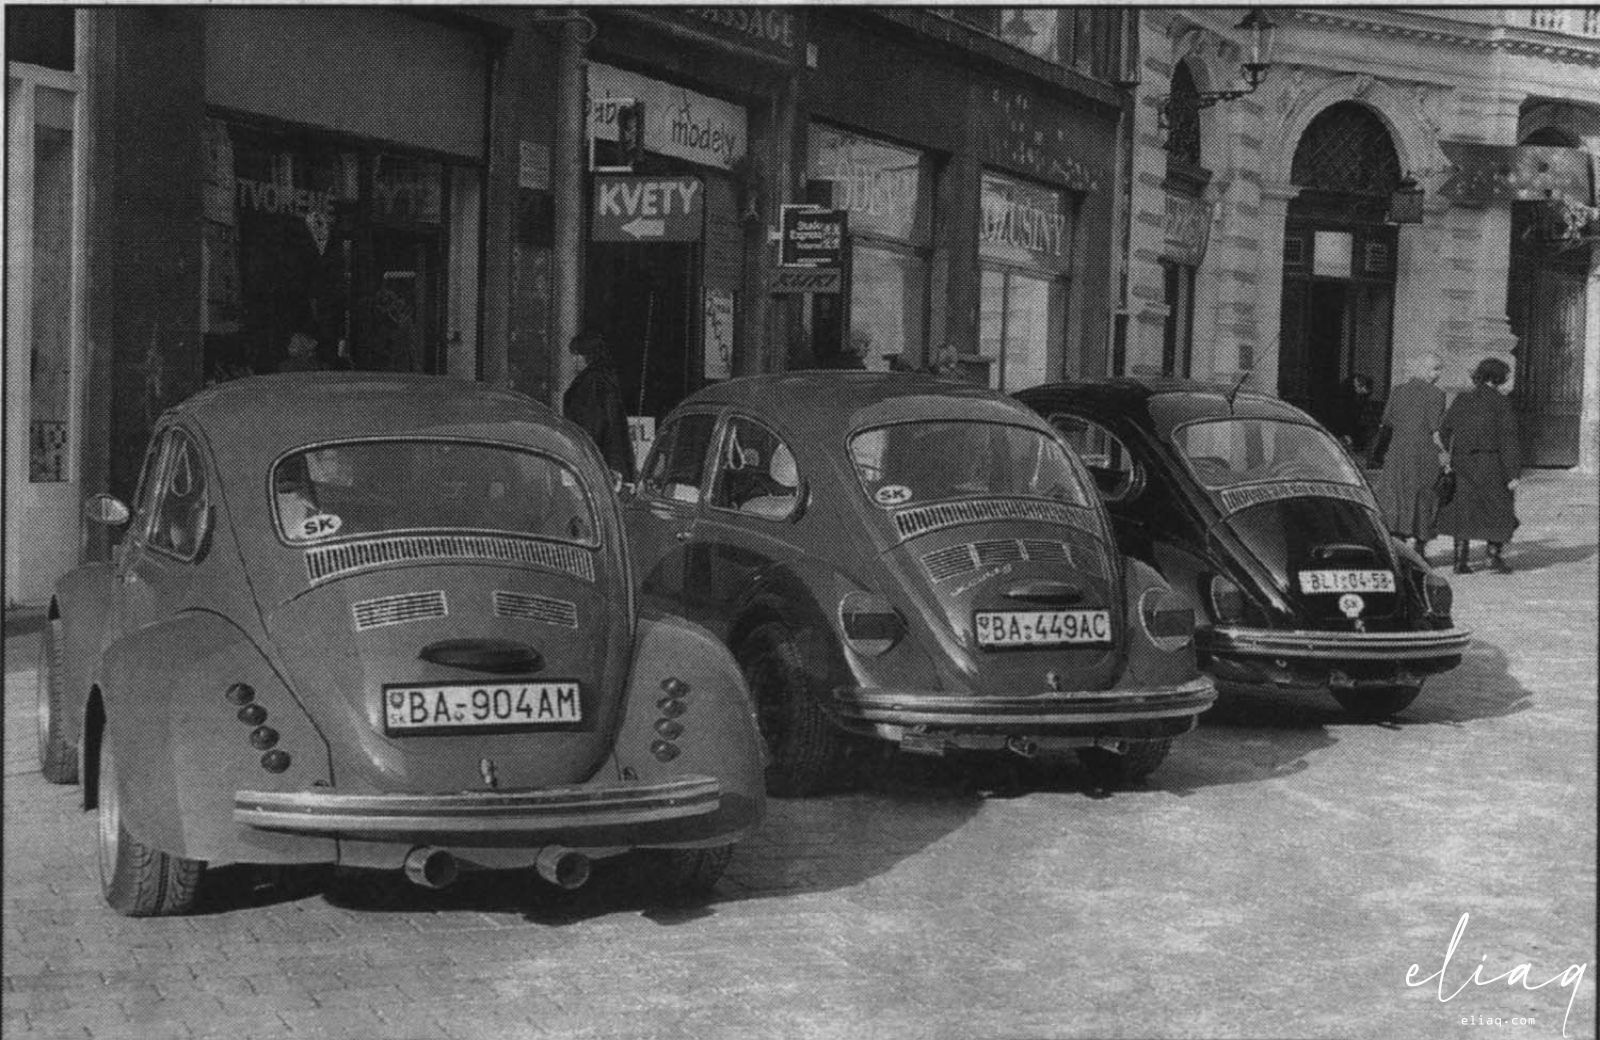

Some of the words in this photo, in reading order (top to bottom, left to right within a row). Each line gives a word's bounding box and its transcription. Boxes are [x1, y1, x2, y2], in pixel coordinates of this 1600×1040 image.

[671, 117, 736, 165] modely
[599, 181, 698, 216] KVETY
[879, 489, 906, 501] SK
[304, 517, 335, 535] SK
[409, 686, 576, 724] BA-904AM
